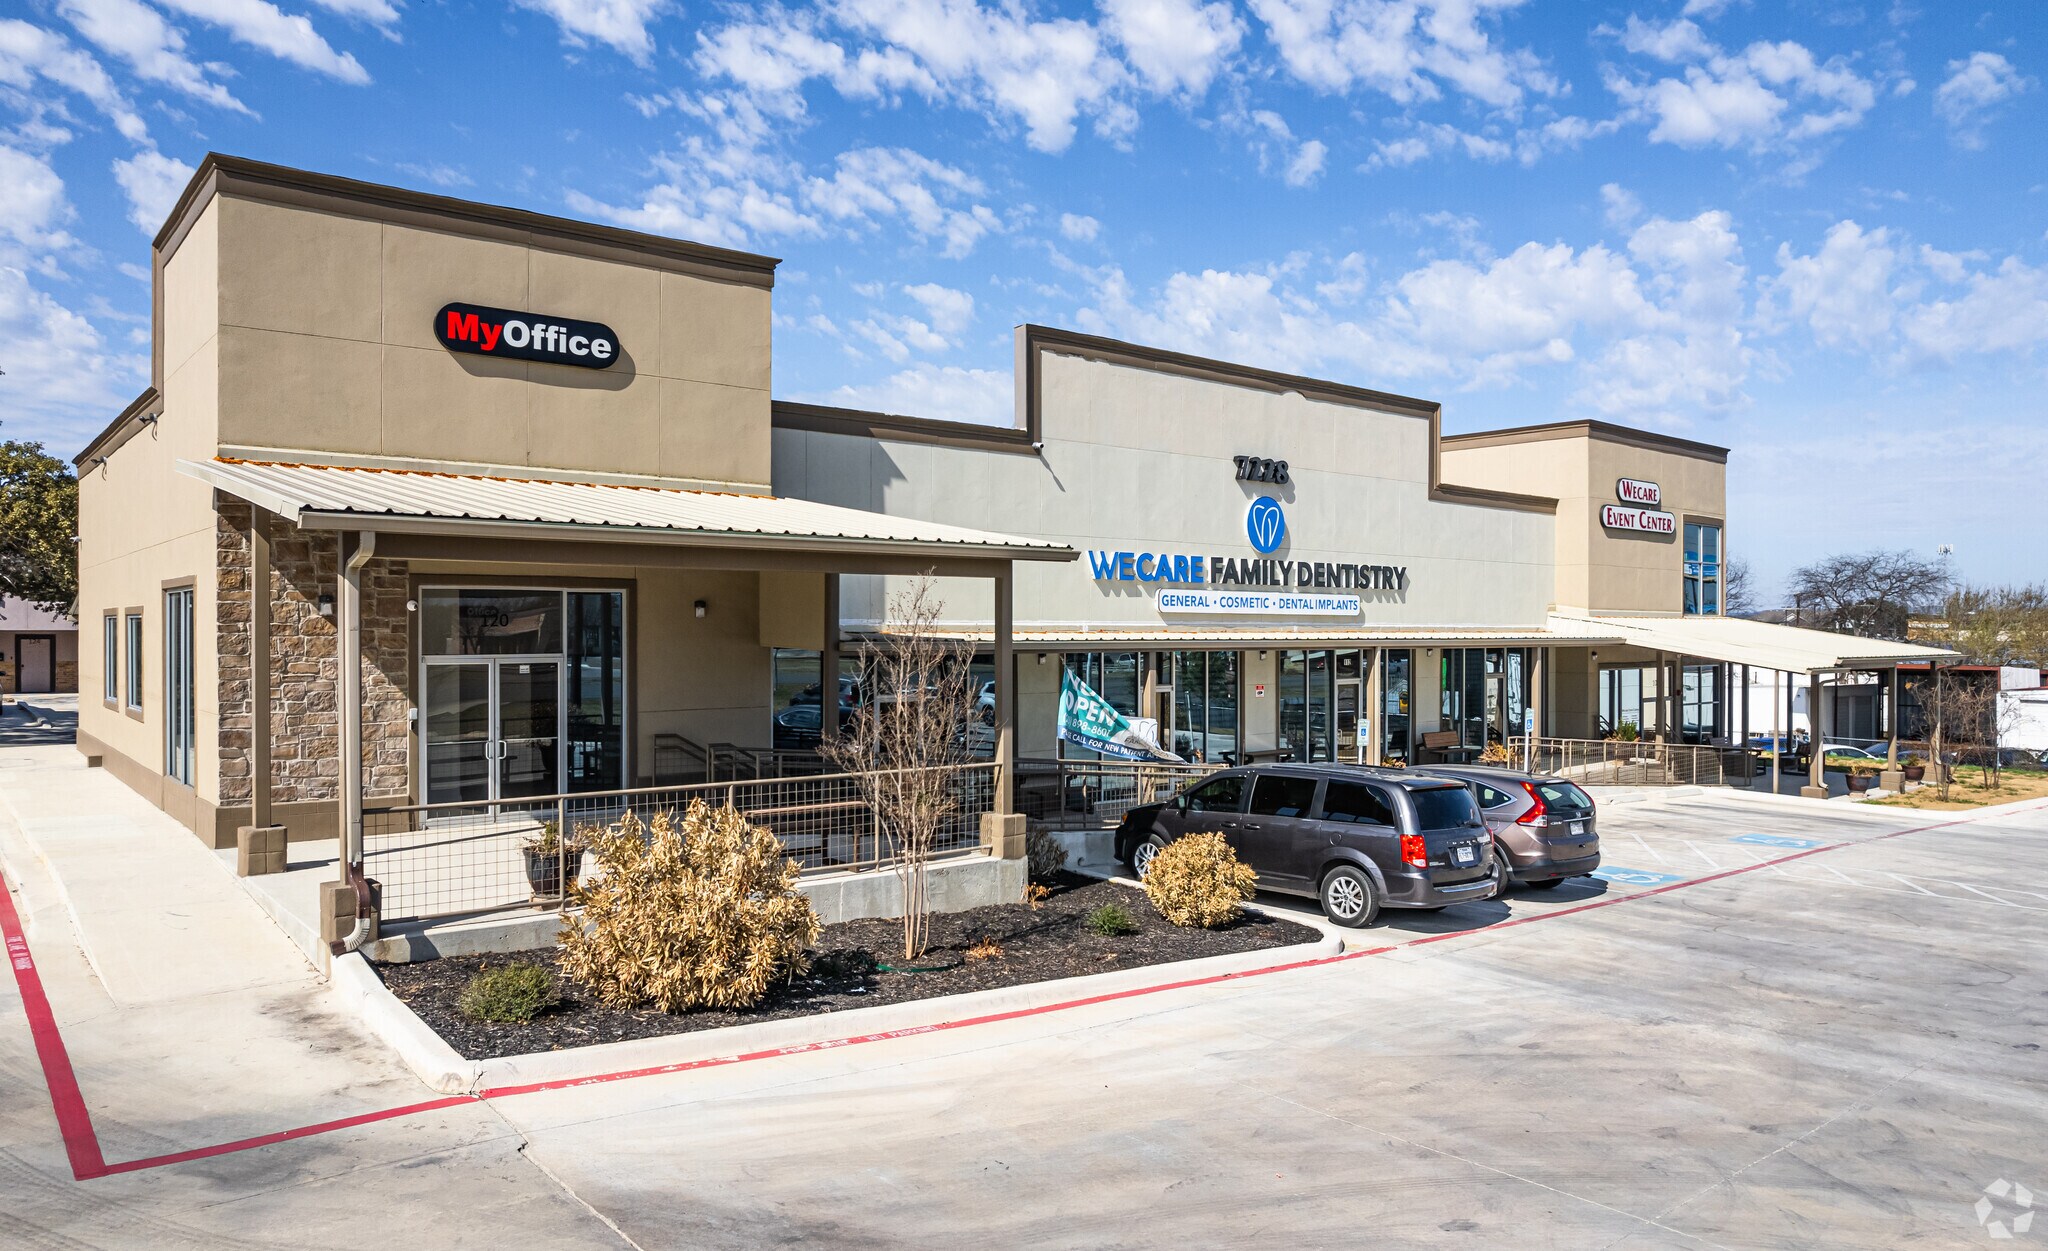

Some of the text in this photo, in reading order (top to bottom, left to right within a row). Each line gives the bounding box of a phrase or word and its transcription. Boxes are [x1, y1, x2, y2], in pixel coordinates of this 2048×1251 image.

[447, 311, 612, 359] MyOffice
[1233, 455, 1289, 484] 7228
[1088, 550, 1407, 590] WECARE FAMILY DENTISTRY
[1161, 594, 1358, 611] GENERAL COSMETIC DENTAL IMPLANTS
[481, 613, 509, 627] 120
[1066, 690, 1119, 727] OPEN
[1072, 734, 1087, 745] CALL
[1088, 739, 1103, 749] FOR
[1104, 744, 1120, 753] NEW
[1120, 745, 1146, 757] PATIENT
